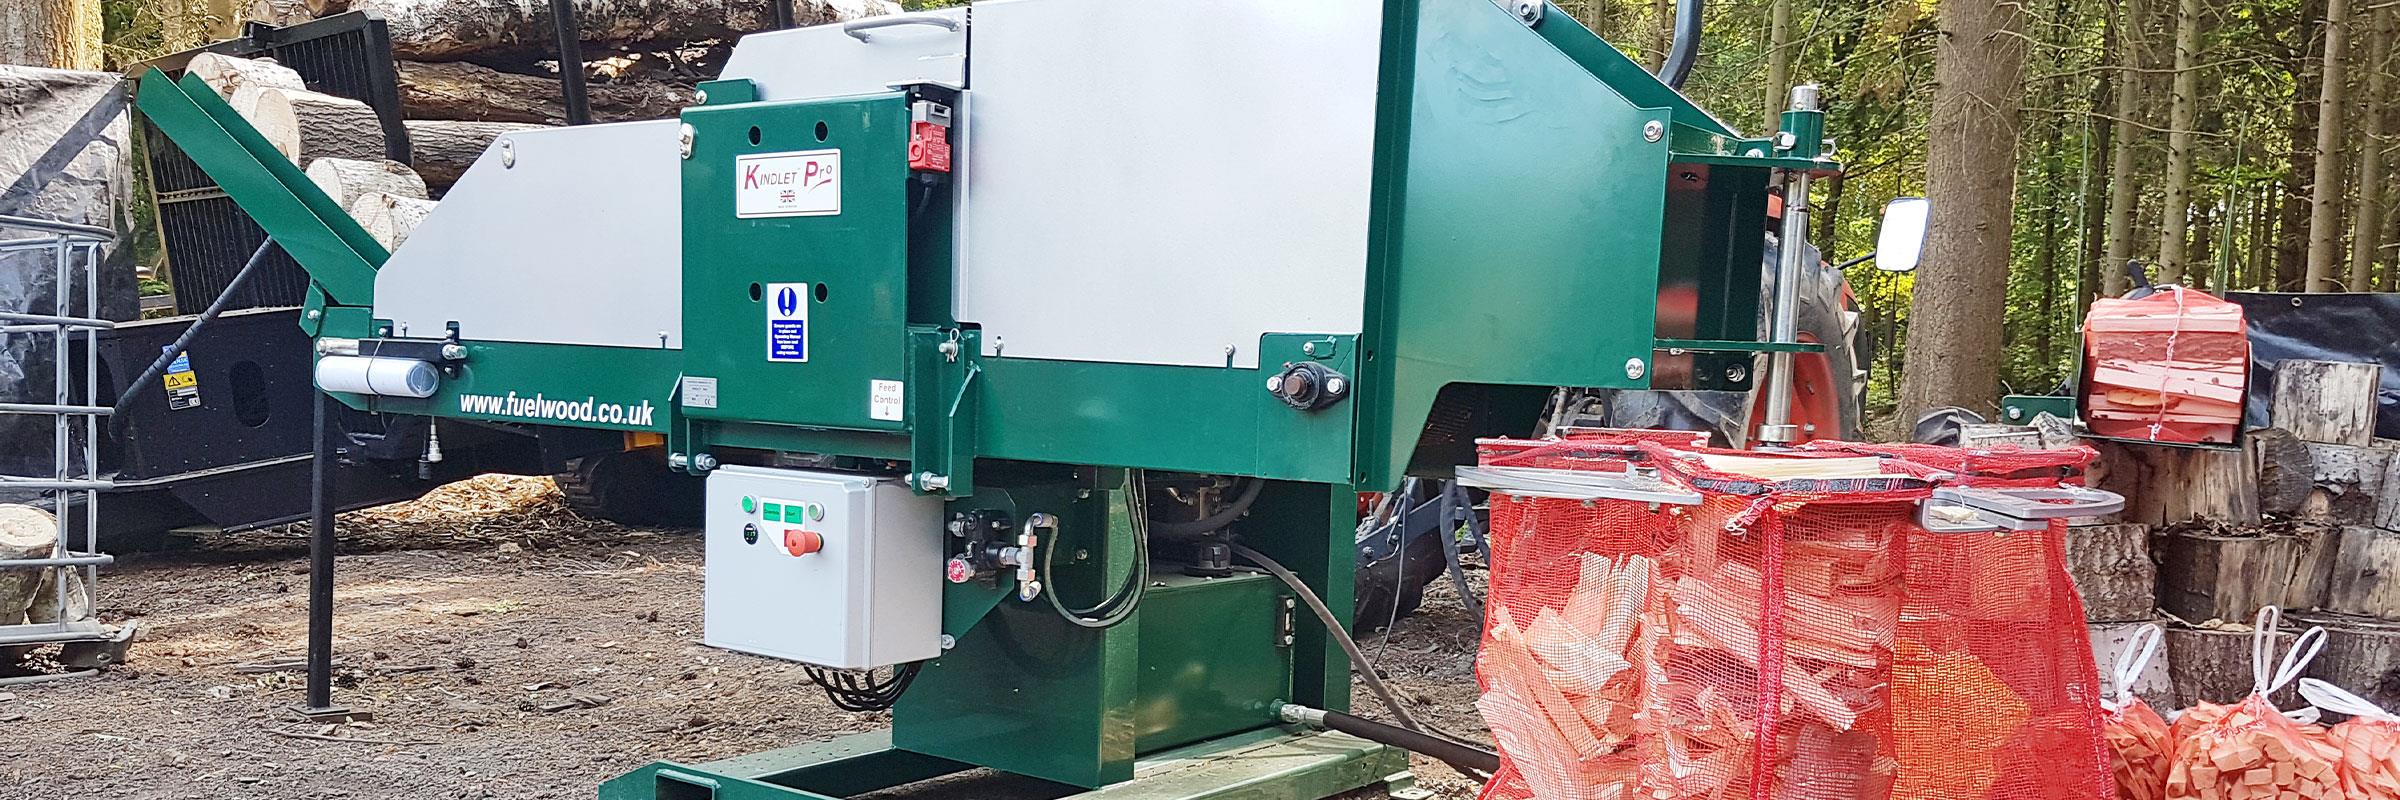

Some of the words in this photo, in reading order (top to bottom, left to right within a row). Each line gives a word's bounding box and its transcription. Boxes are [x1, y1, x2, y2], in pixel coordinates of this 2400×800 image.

[803, 161, 832, 187] Pro
[879, 382, 897, 392] Feed
[460, 391, 655, 426] www.fuelwood.co.uk
[874, 394, 900, 405] Control
